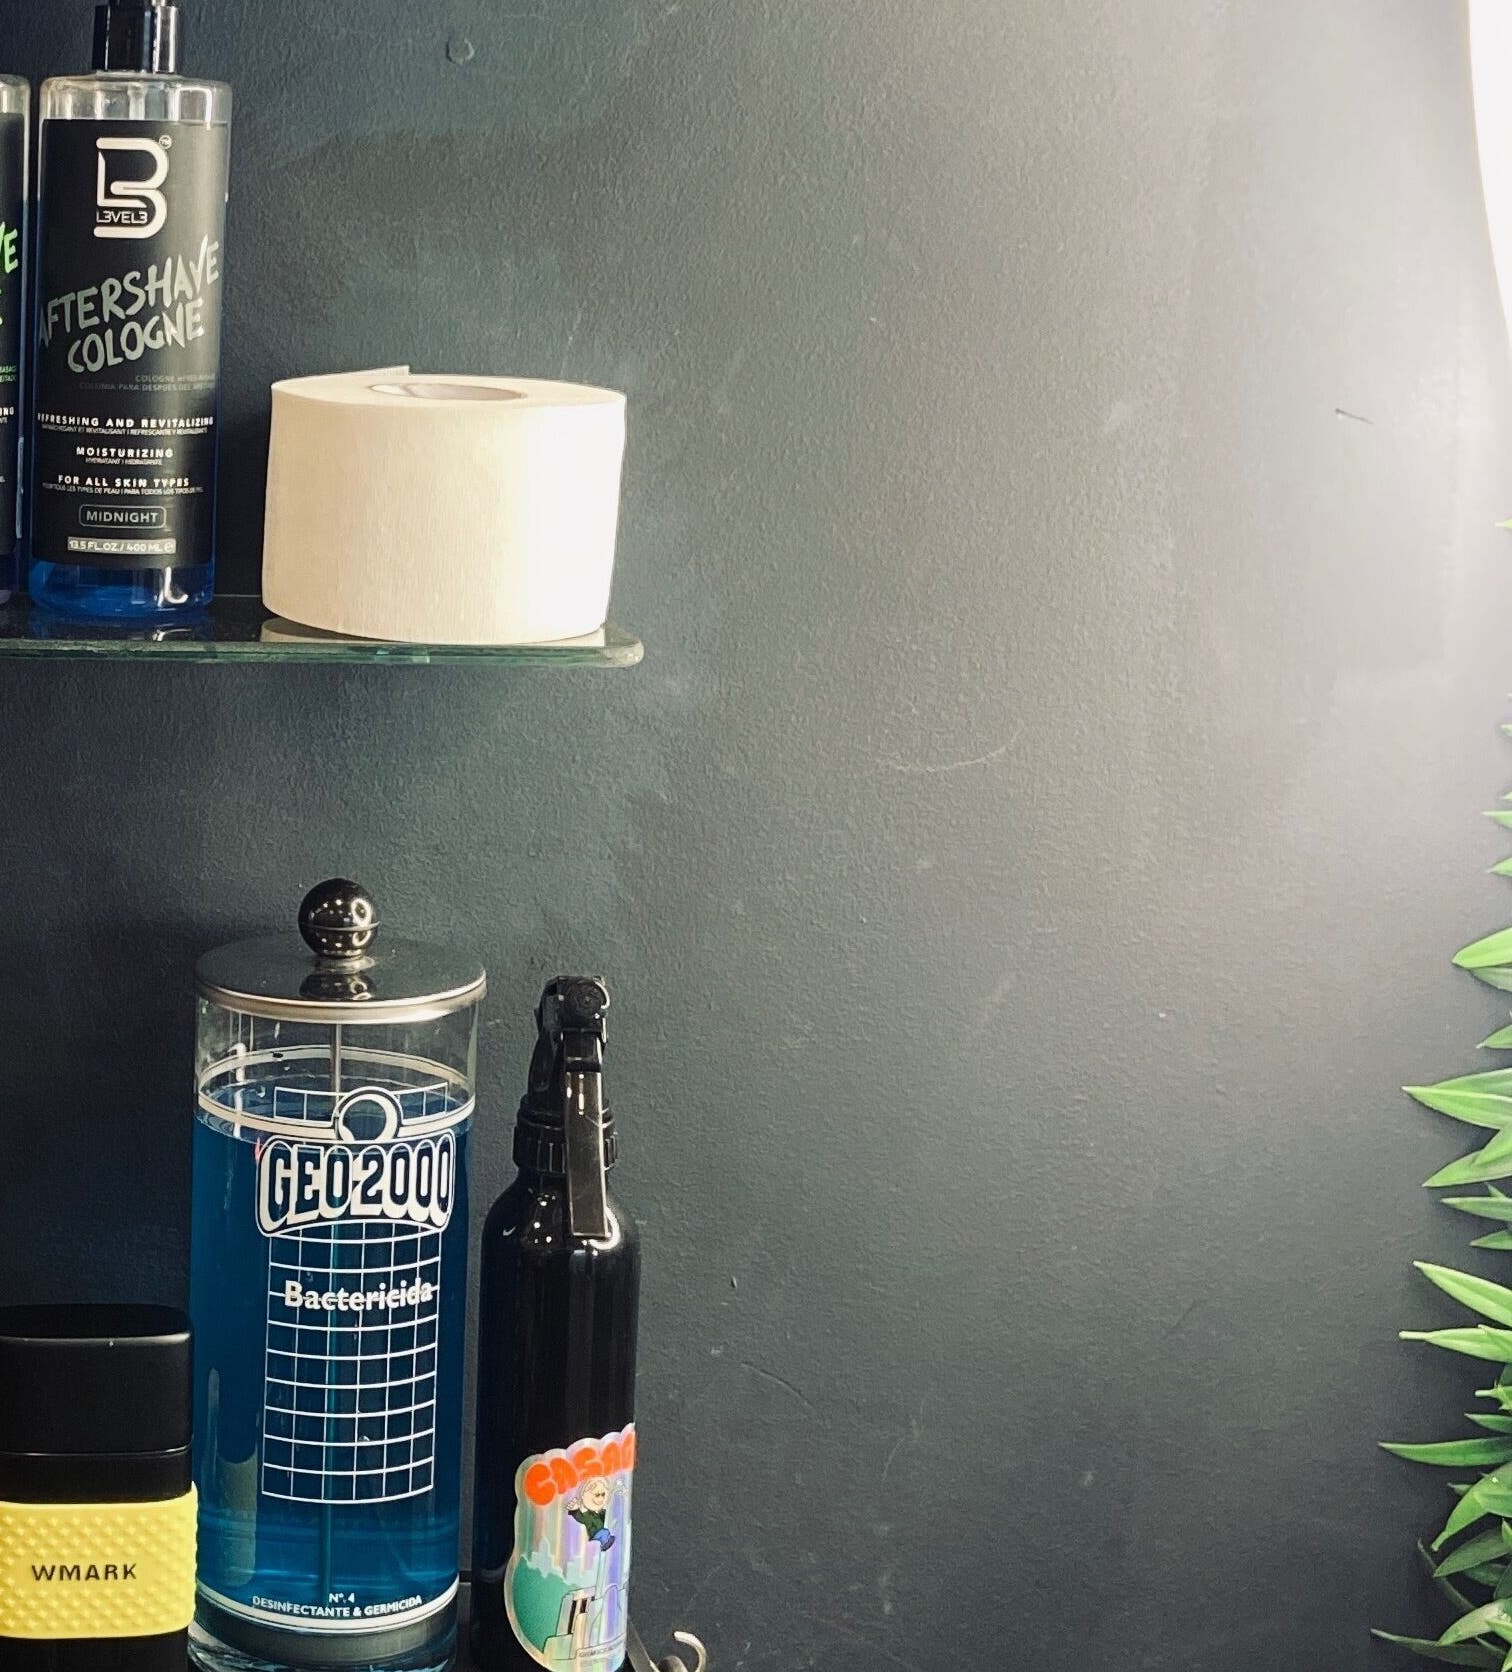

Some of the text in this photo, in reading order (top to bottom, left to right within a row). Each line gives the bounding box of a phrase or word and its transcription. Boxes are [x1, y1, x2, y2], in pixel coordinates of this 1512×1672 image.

[39, 234, 219, 347] AFTERSHAVE
[68, 298, 205, 374] COLOGNE
[106, 418, 134, 428] AND
[141, 416, 214, 428] REVITALIZING
[76, 446, 174, 458] MOISTURIZING
[58, 474, 189, 488] FOR ALL SKIN TYPES
[86, 511, 158, 523] MIDNIGHT
[127, 542, 147, 552] 400
[284, 1277, 433, 1311] Bactericida
[31, 1563, 137, 1581] WMARK
[348, 1592, 355, 1603] 4
[252, 1594, 423, 1617] DESINFECTANTE & GERMICIDA
